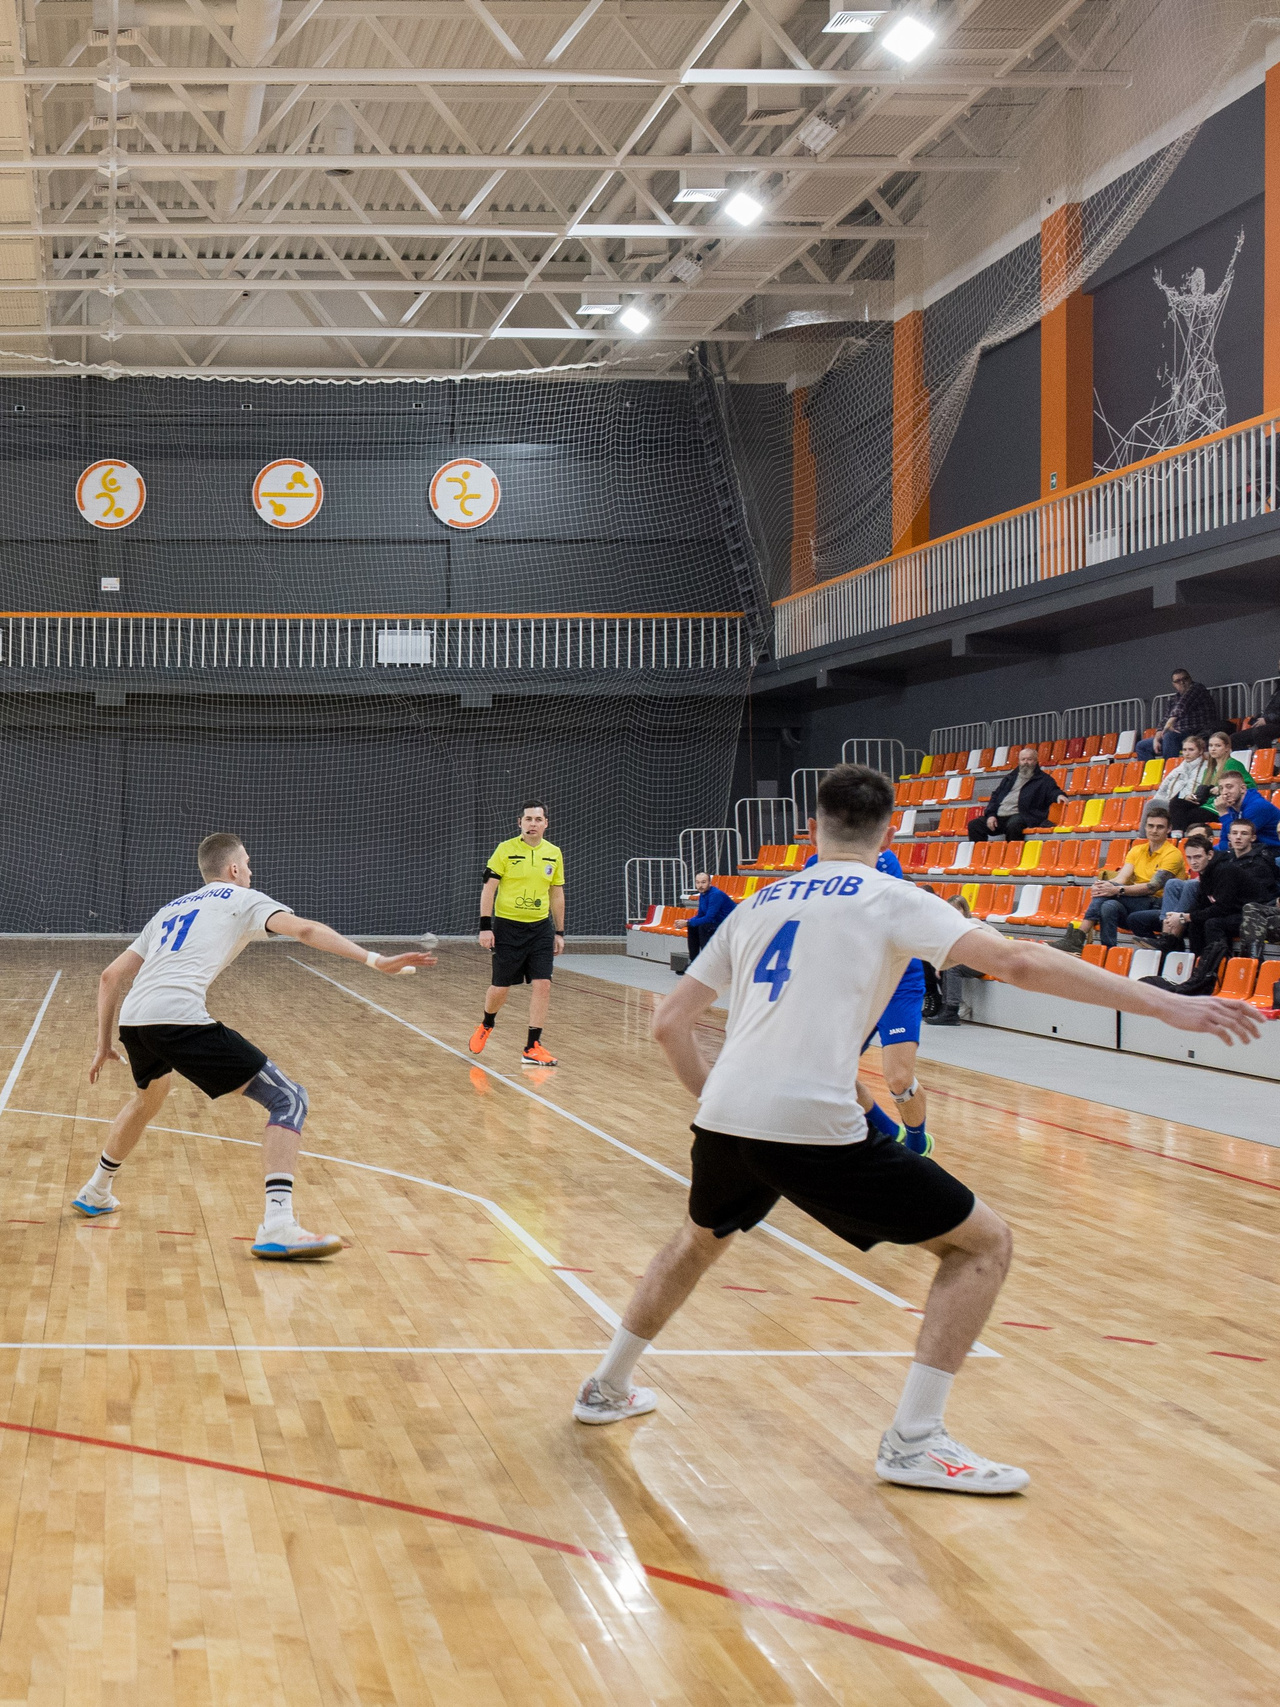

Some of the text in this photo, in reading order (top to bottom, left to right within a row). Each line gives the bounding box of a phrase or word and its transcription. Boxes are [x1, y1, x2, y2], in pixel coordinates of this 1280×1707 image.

[752, 875, 864, 909] ПЕТРОВ
[155, 909, 200, 952] 11
[753, 920, 801, 1002] 4
[888, 1027, 906, 1035] JAKO
